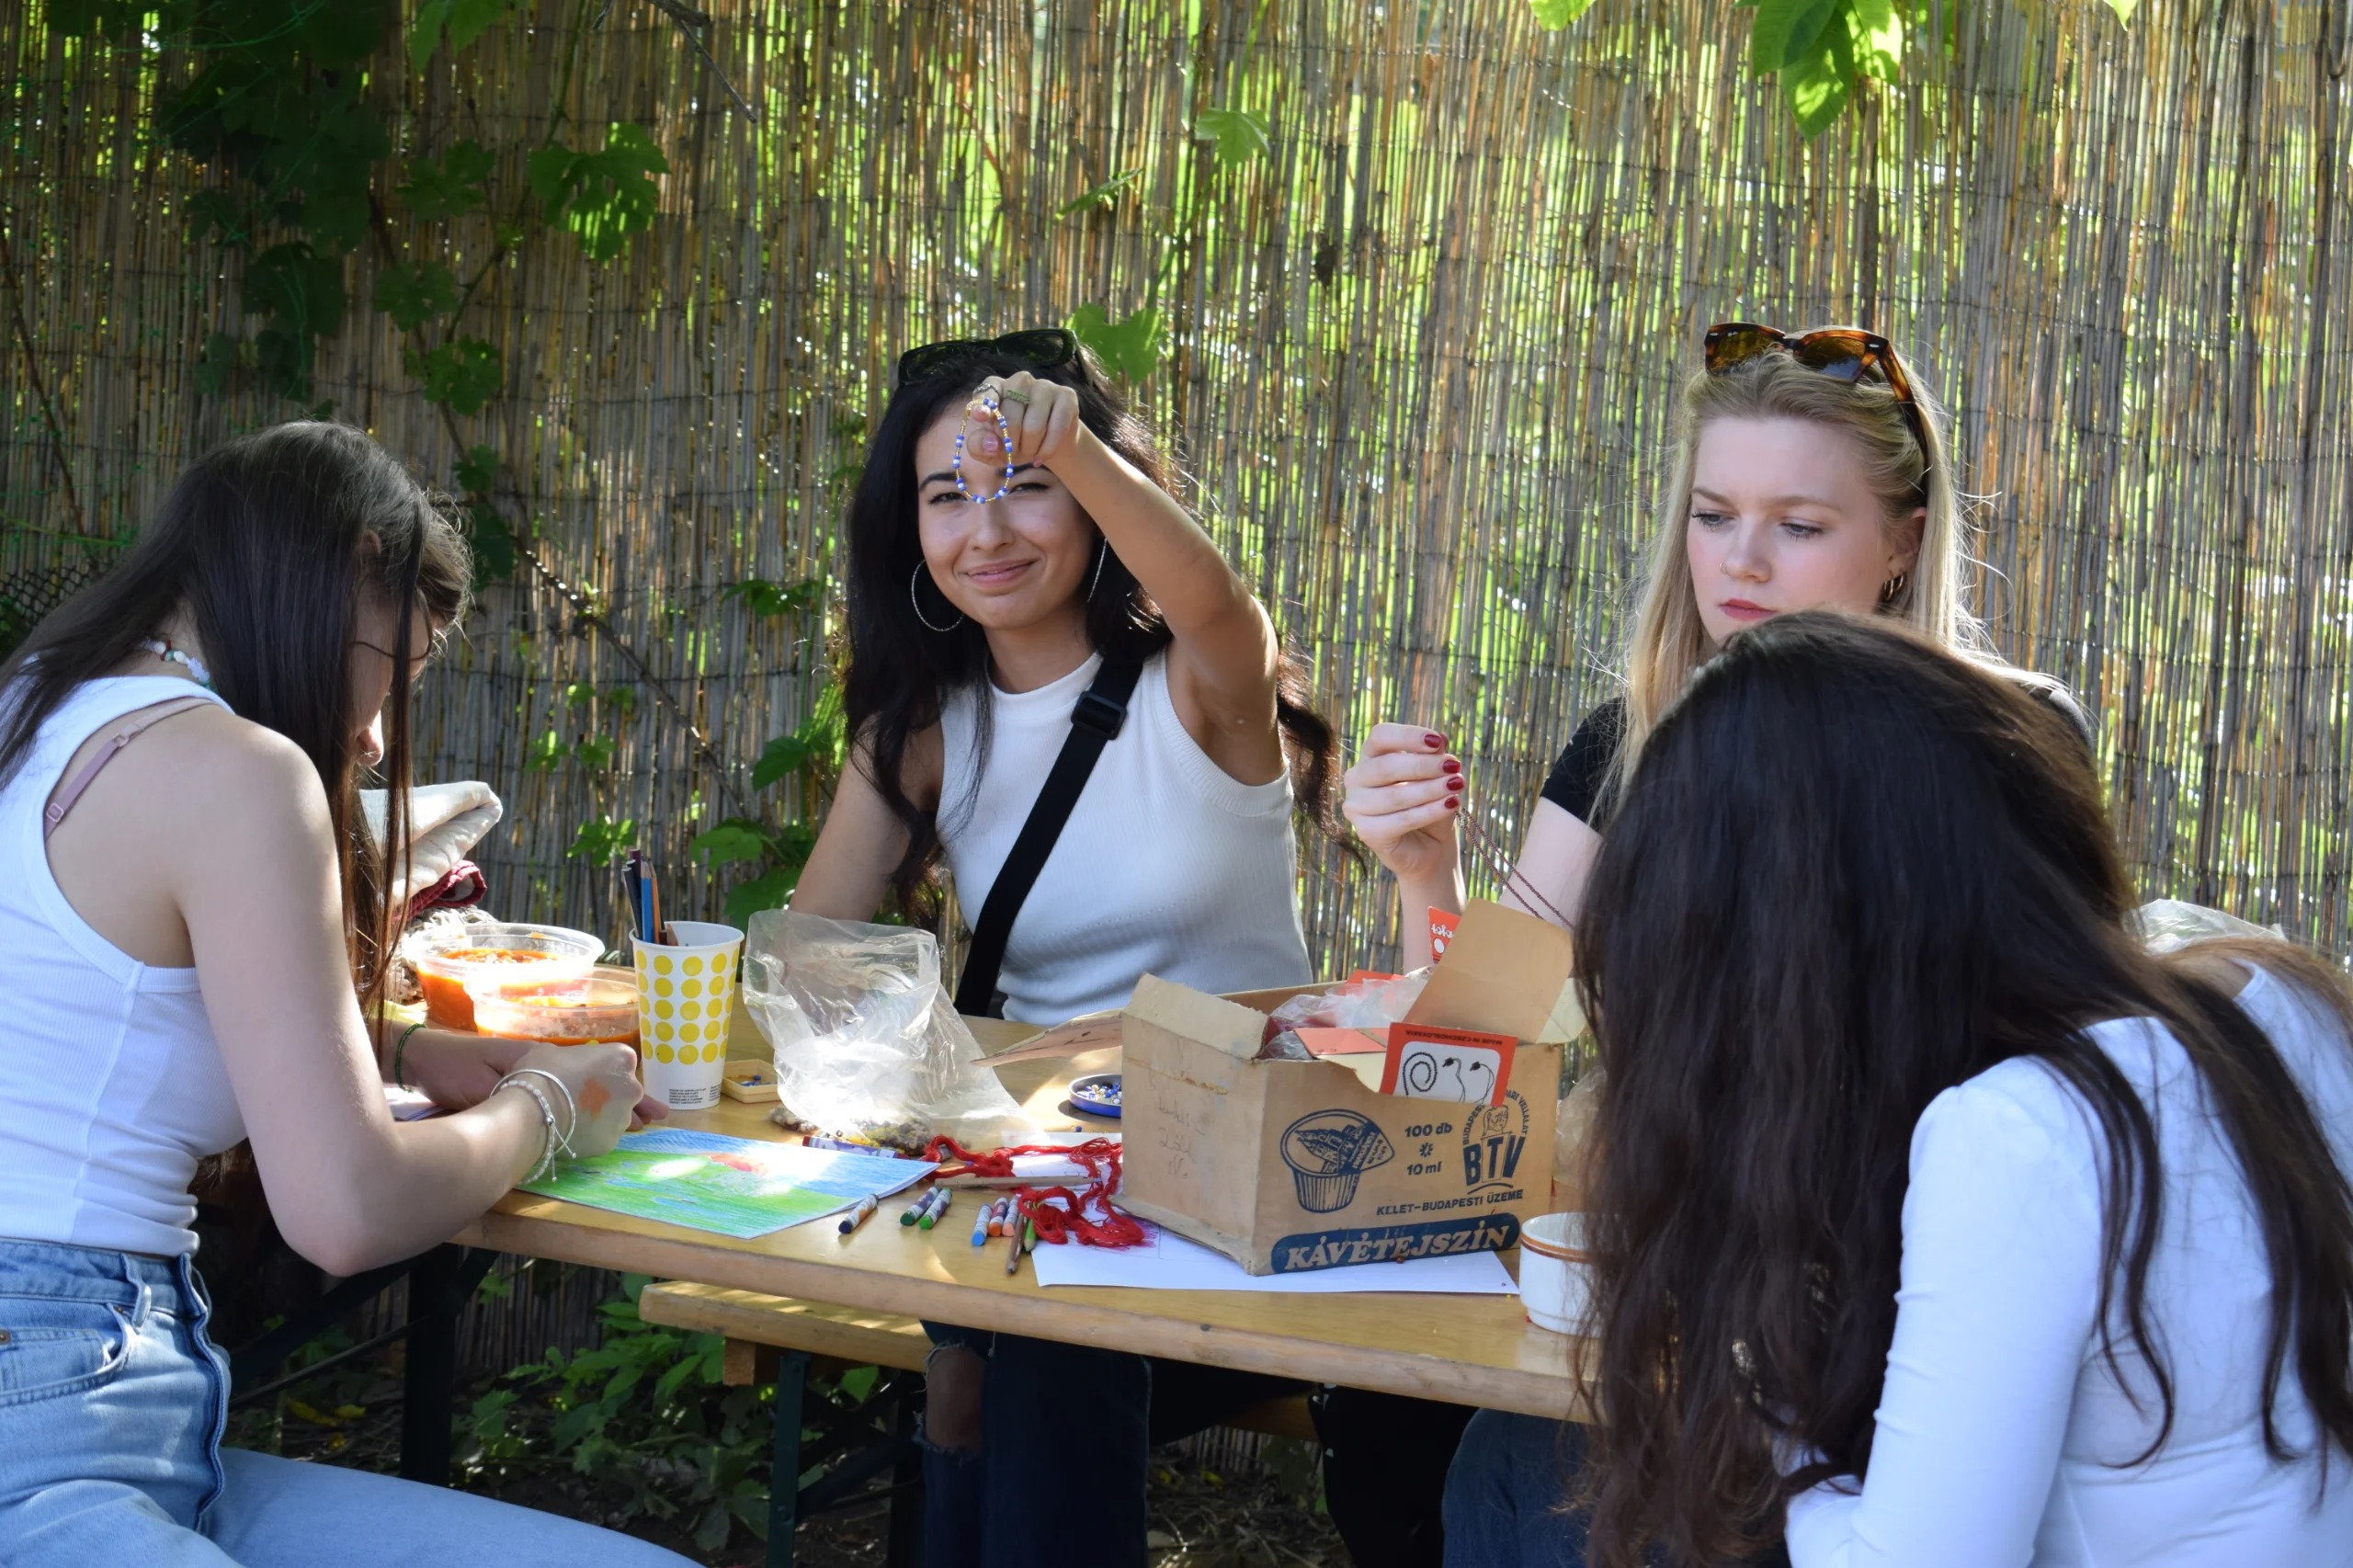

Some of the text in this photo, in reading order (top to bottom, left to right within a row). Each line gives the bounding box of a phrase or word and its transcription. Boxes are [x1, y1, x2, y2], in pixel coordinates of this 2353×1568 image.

[1405, 1029, 1472, 1042] CZECHOSLOVAKIA
[1482, 1038, 1504, 1046] MADE
[1404, 1122, 1452, 1138] 100 db
[1406, 1161, 1442, 1176] 10 ml
[1462, 1134, 1526, 1187] BTV
[1486, 1188, 1524, 1204] ÜZEME
[1284, 1220, 1510, 1271] KÁVÉTEJSZÍN
